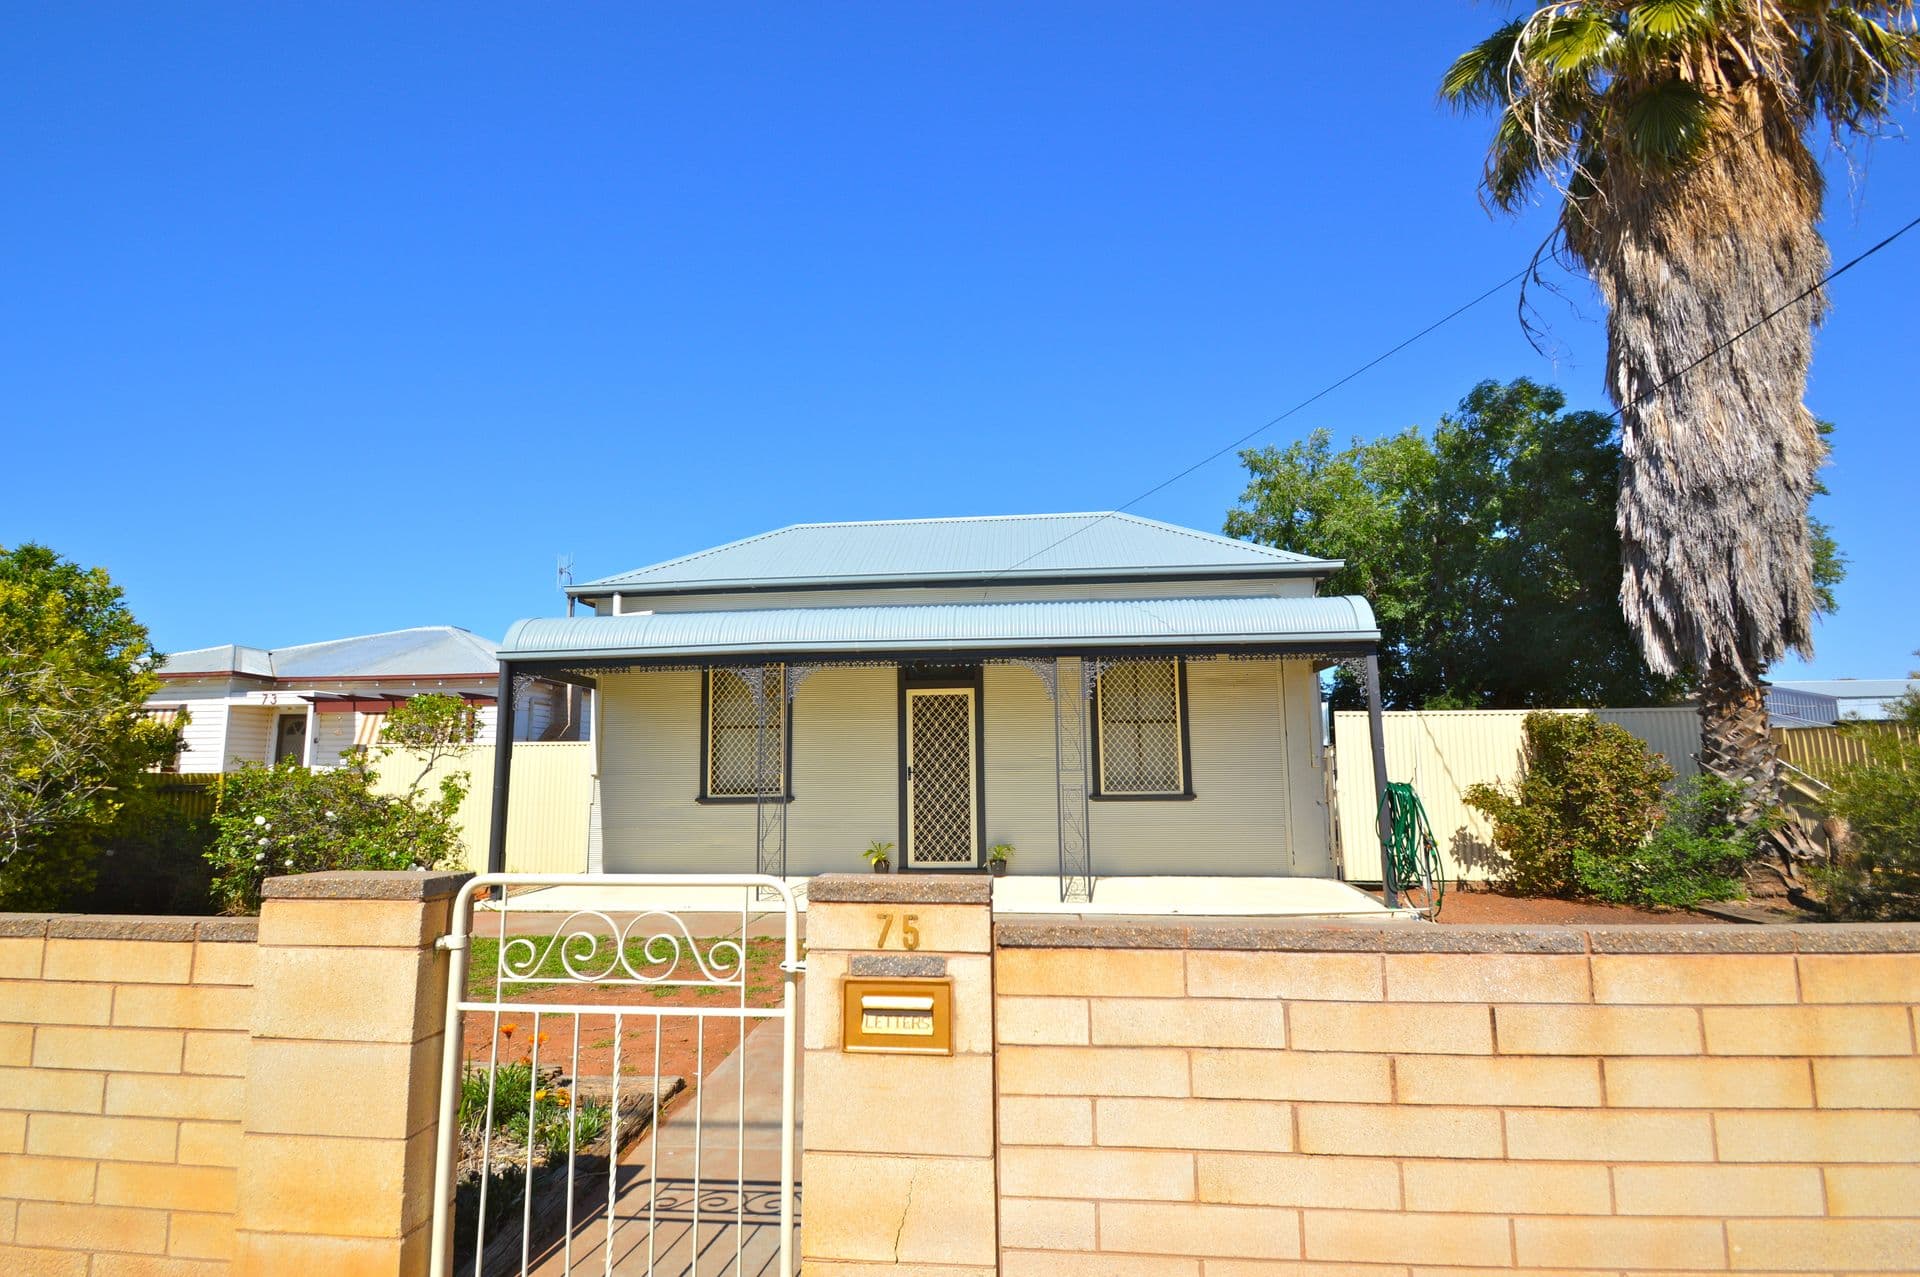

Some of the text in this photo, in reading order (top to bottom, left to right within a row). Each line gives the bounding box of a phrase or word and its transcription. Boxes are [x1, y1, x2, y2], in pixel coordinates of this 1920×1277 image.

[262, 693, 277, 705] 73
[876, 914, 920, 950] 75
[865, 1014, 931, 1029] LETTERS
